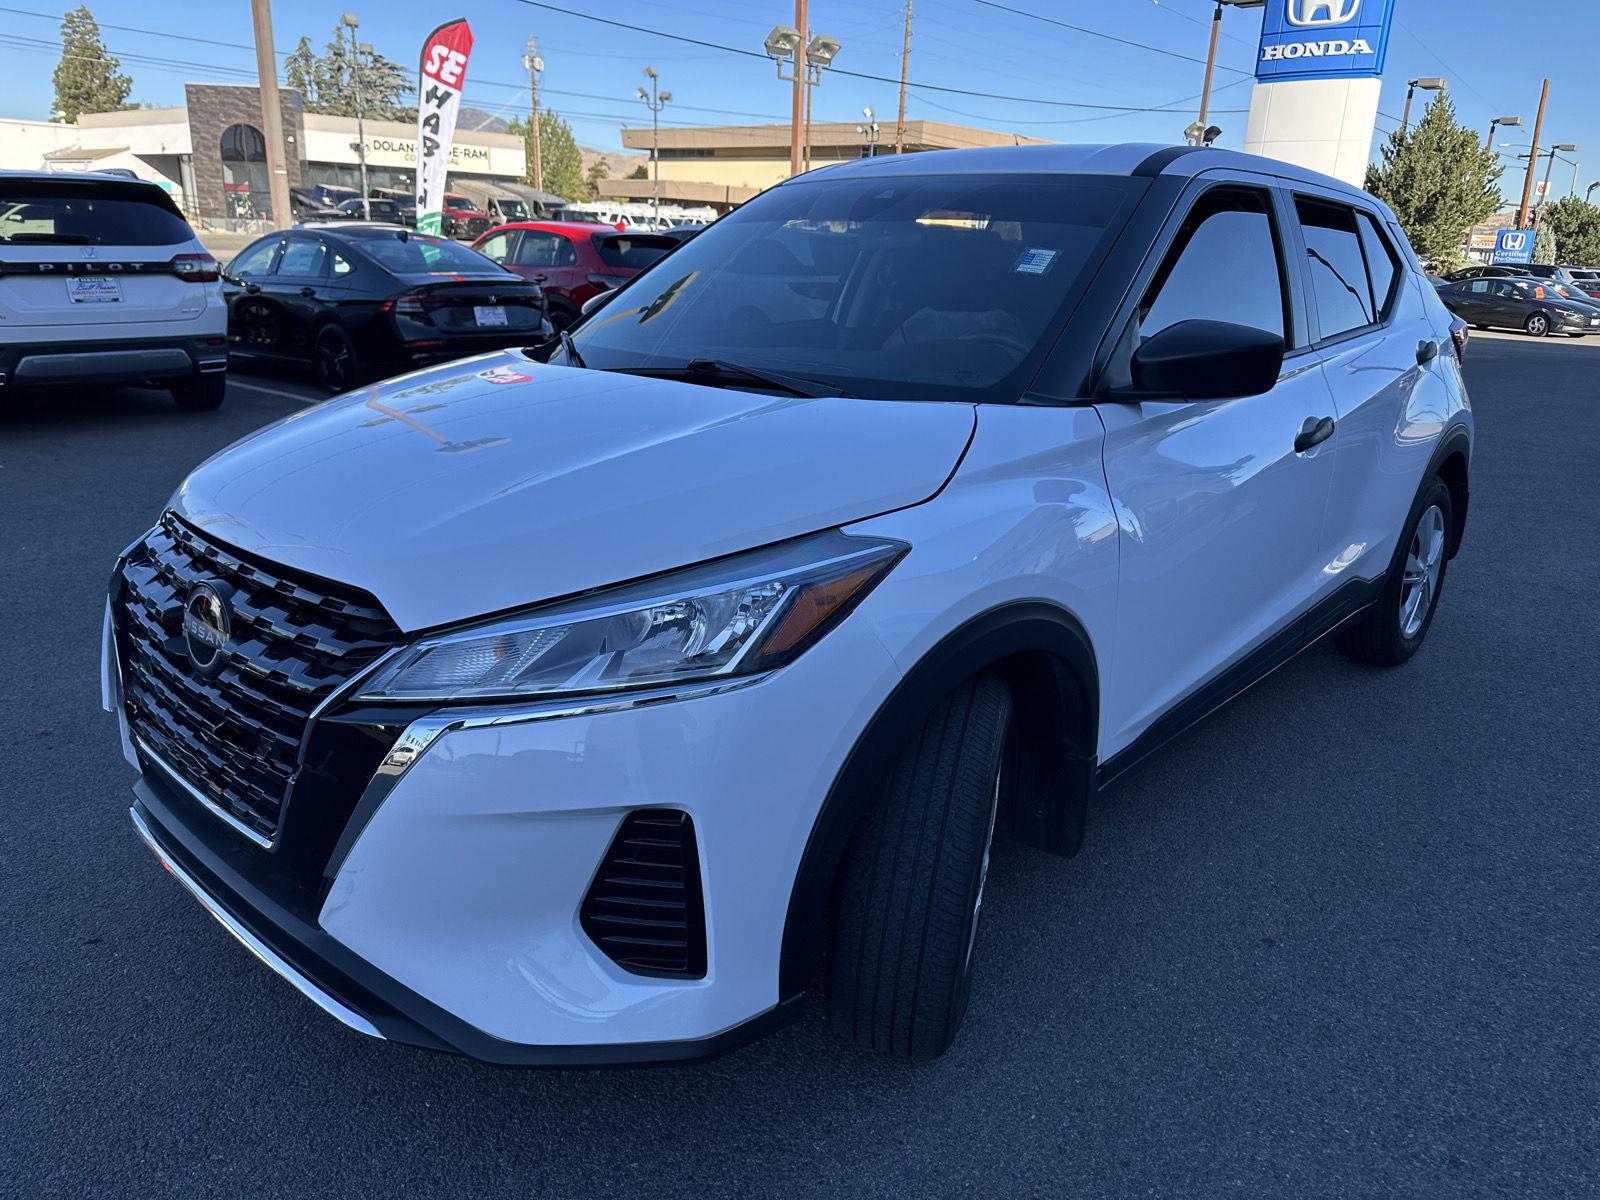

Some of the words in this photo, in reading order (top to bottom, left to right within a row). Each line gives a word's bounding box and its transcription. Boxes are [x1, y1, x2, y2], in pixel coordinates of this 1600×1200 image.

[425, 44, 467, 85] SE
[1262, 39, 1374, 61] HONDA
[39, 263, 144, 271] PILOT
[184, 609, 226, 646] NISSAN
